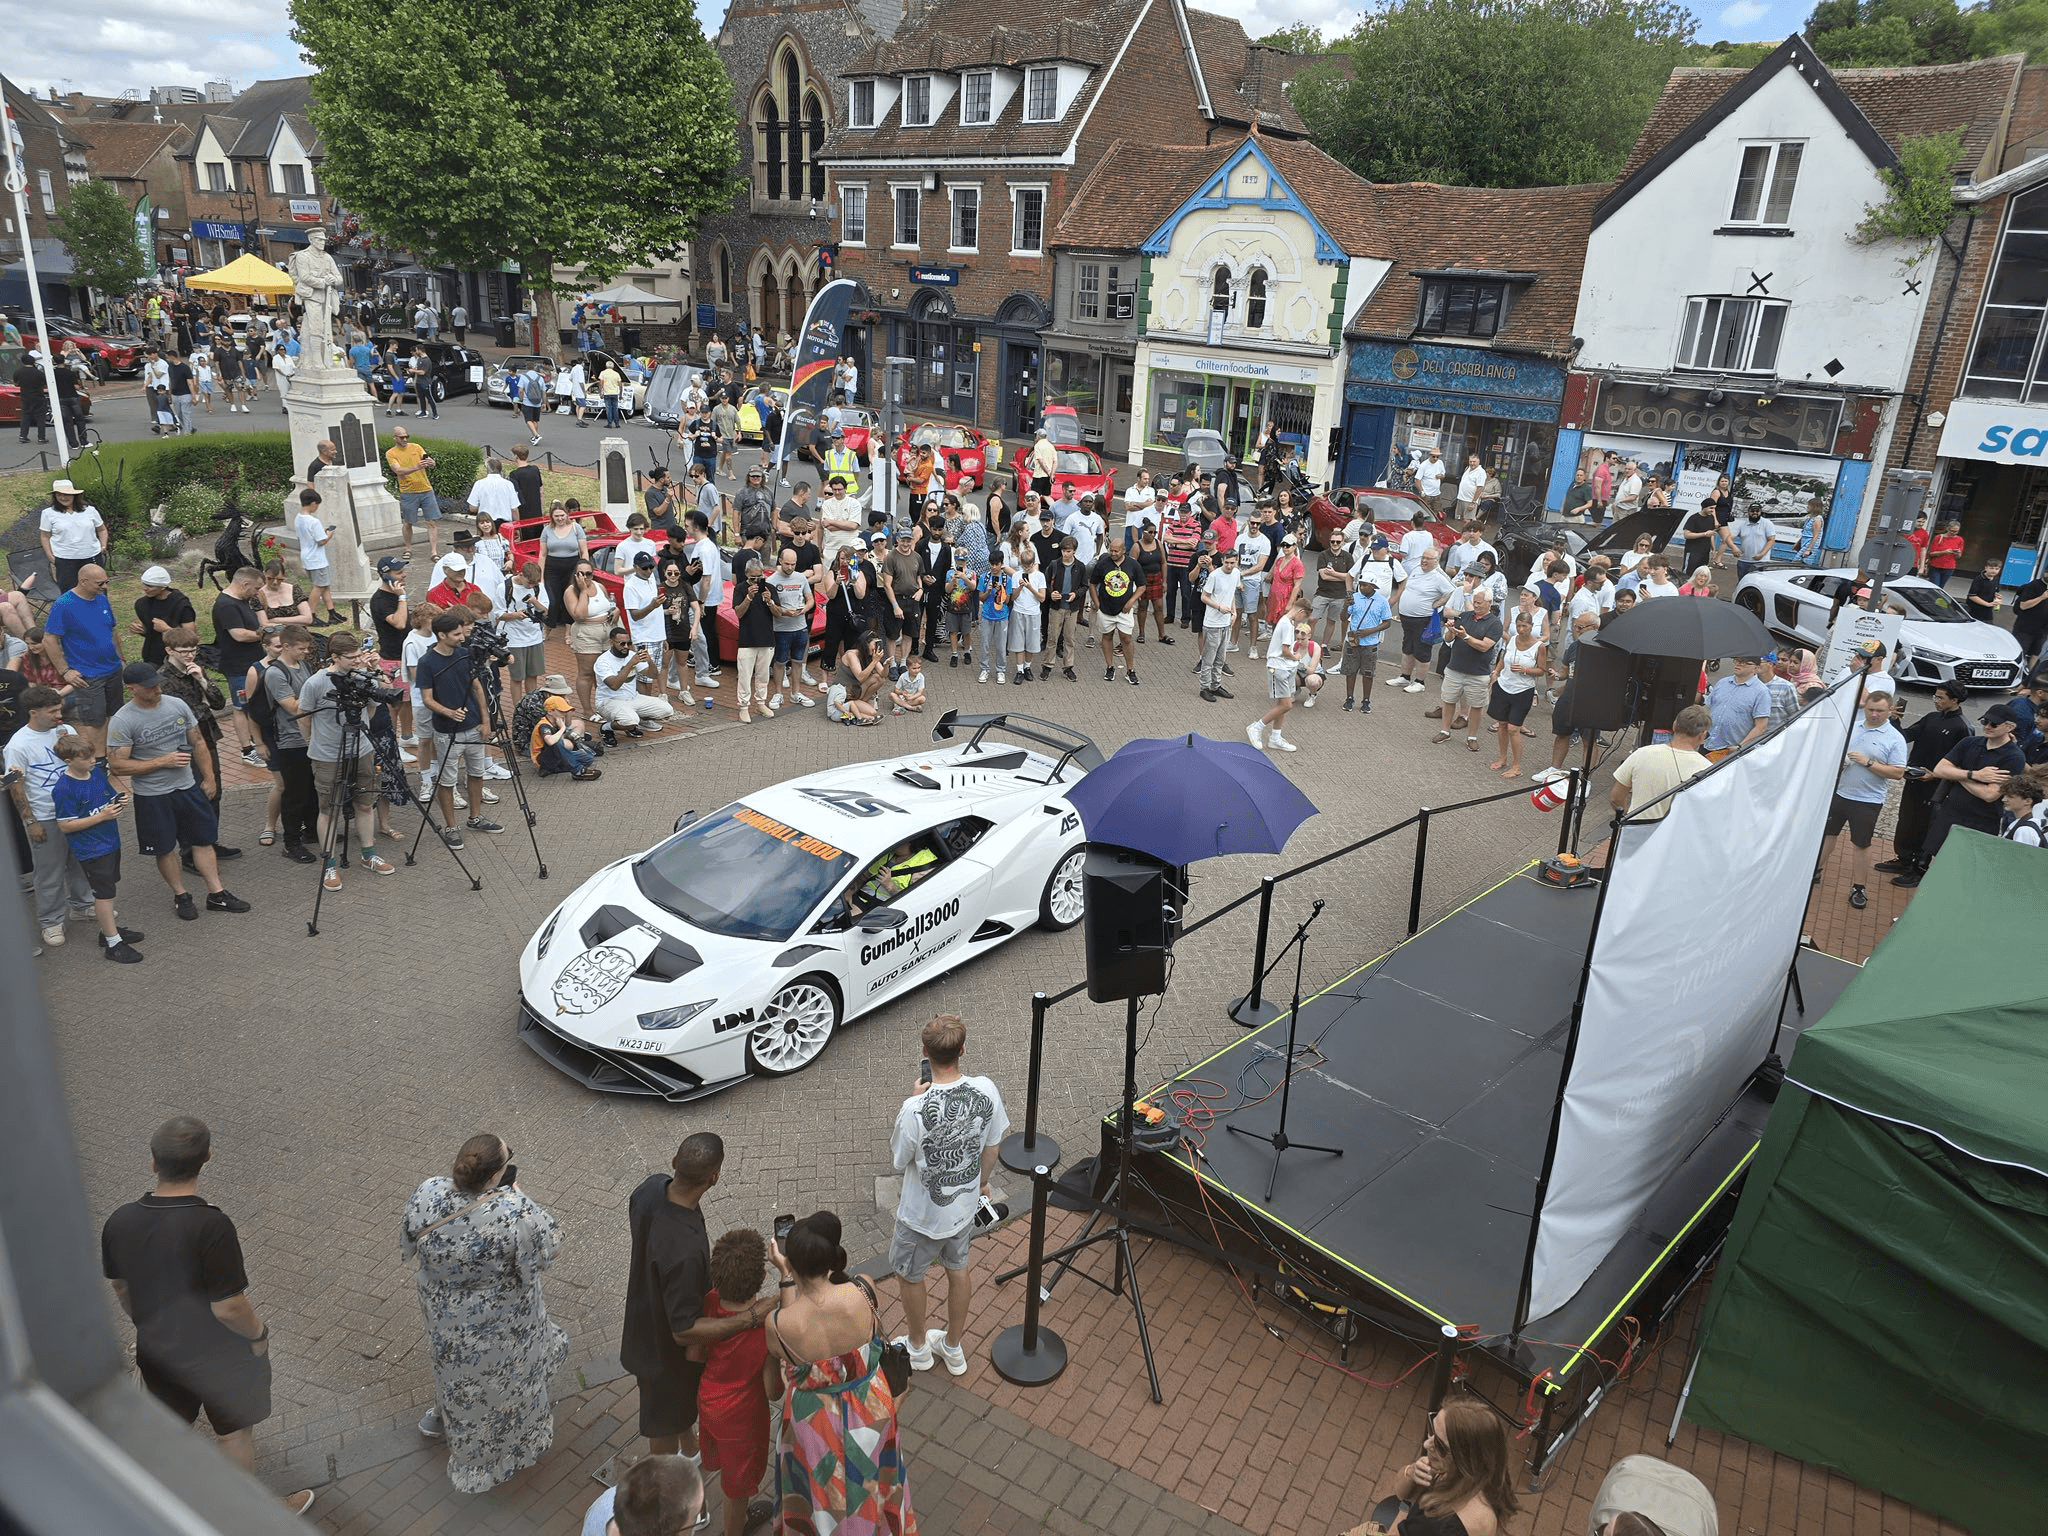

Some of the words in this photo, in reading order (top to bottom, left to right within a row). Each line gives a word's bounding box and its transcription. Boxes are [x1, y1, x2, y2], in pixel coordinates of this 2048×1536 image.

[138, 227, 149, 245] Aid
[206, 223, 240, 240] WHSmith
[1088, 343, 1110, 353] Broadway
[1195, 360, 1229, 372] Chiltern
[1229, 362, 1269, 376] foodbank
[1422, 359, 1444, 373] DELI
[1447, 361, 1516, 380] CASABLANCA
[796, 414, 818, 425] Warranty
[1677, 490, 1694, 498] Now
[1993, 670, 2007, 678] LOW
[791, 787, 912, 818] AS
[1058, 811, 1080, 837] AS
[732, 808, 799, 843] GUMBALL
[790, 835, 844, 861] 3000
[643, 922, 663, 935] STO
[860, 896, 960, 966] Gumball3000
[587, 946, 637, 984] GUM
[869, 969, 899, 992] AUTO
[899, 933, 959, 974] SANCTUARY
[712, 1007, 756, 1034] LDN
[618, 1038, 642, 1049] MX23
[643, 1041, 663, 1052] DFU
